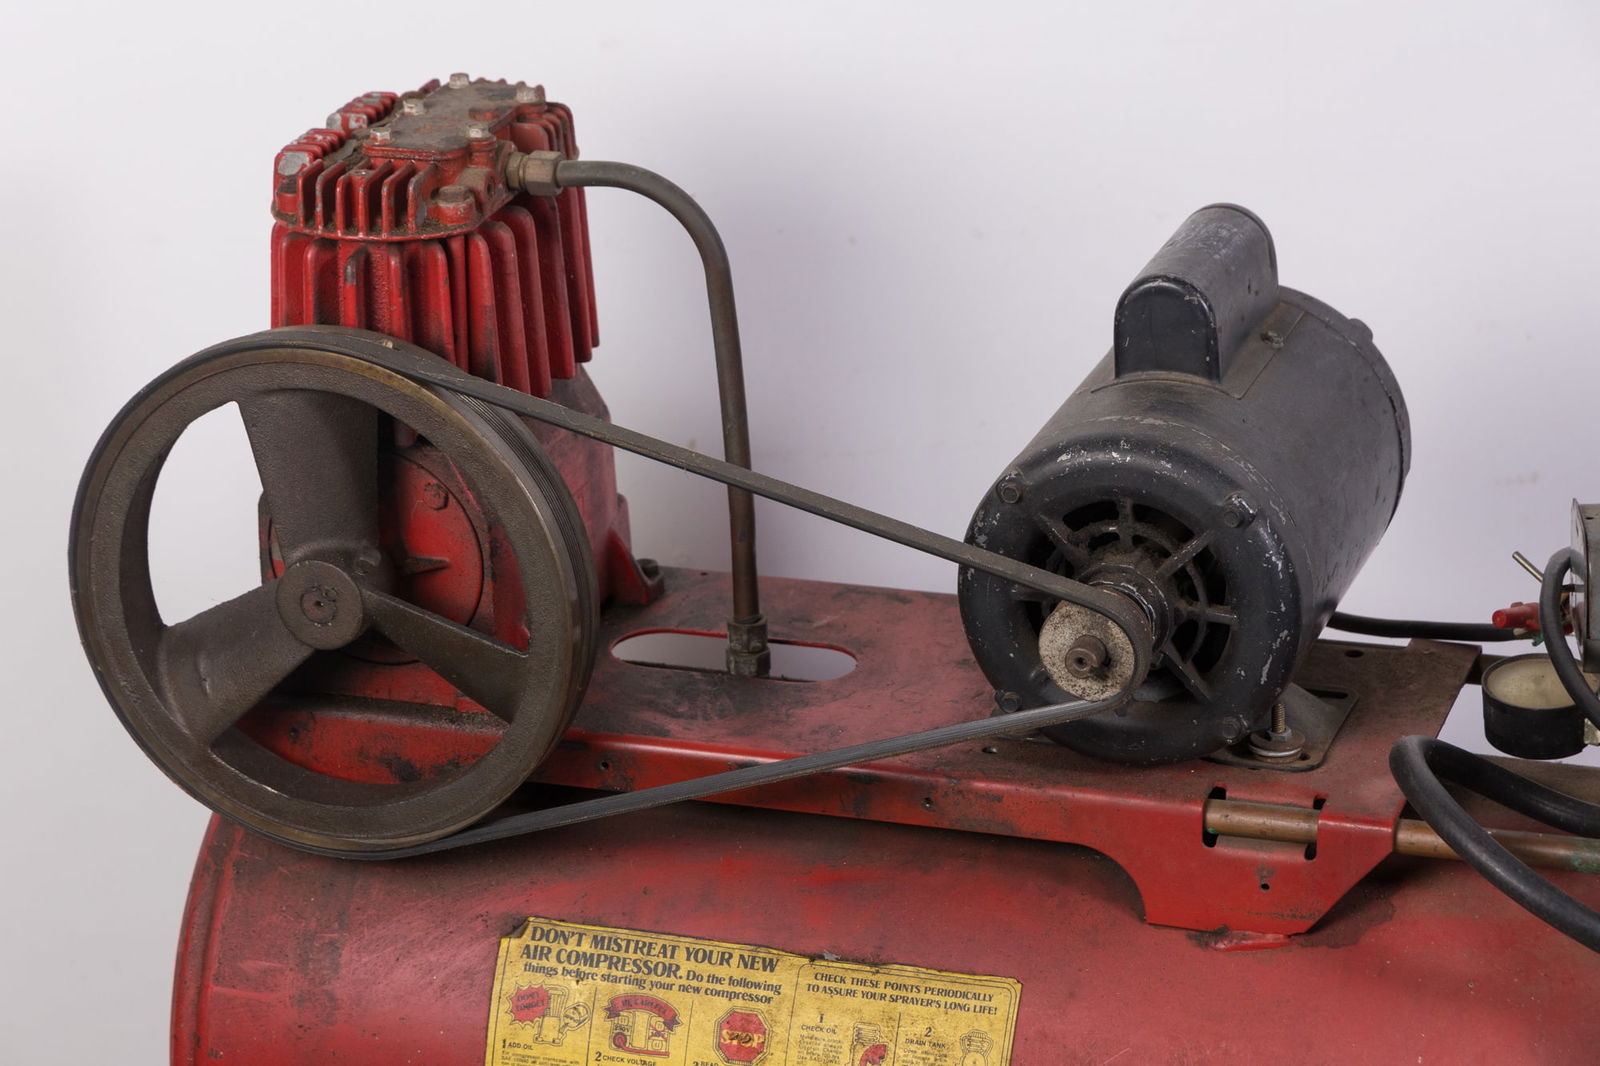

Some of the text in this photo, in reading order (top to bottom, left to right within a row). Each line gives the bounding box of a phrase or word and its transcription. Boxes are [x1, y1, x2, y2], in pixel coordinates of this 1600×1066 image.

[531, 926, 780, 973] DON'T MISTREAT YOUR NEW
[520, 944, 782, 996] AIR COMPRESSOR. Do the following
[524, 962, 774, 1004] things before starting your new compressor
[814, 972, 994, 1002] CHECK THESE POINTS PERIODICALLY
[806, 983, 998, 1015] TO ASSURE YOUR SPRAYER'S LONG LIFE!
[801, 1024, 824, 1033] CHECK
[924, 1026, 932, 1038] 2
[502, 1038, 534, 1051] 1 ADD OIL
[905, 1038, 946, 1049] DRAIN TANK
[595, 1051, 657, 1066] 2 CHECK VOLTAGE
